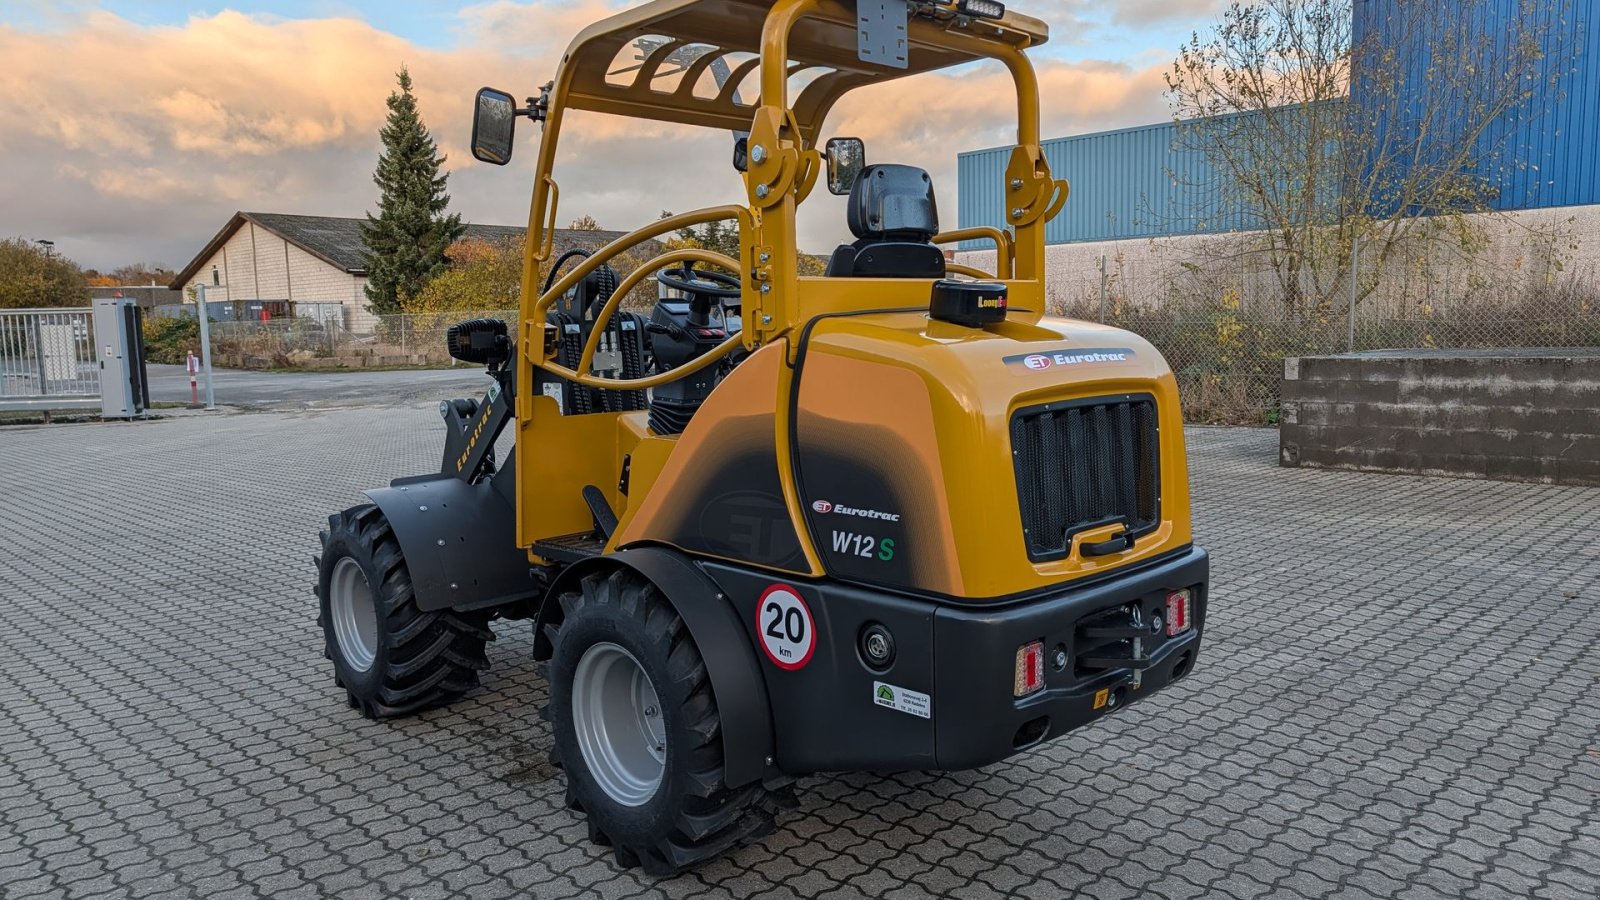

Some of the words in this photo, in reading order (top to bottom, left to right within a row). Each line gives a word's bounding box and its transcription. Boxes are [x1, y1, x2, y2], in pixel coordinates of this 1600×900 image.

[1027, 355, 1051, 369] ET
[1053, 352, 1127, 366] Eurotrac
[456, 403, 492, 473] Eurotrac
[833, 504, 900, 522] Eurotrac
[832, 530, 875, 558] W12
[878, 538, 895, 561] S
[766, 602, 805, 644] 20
[779, 646, 792, 658] km
